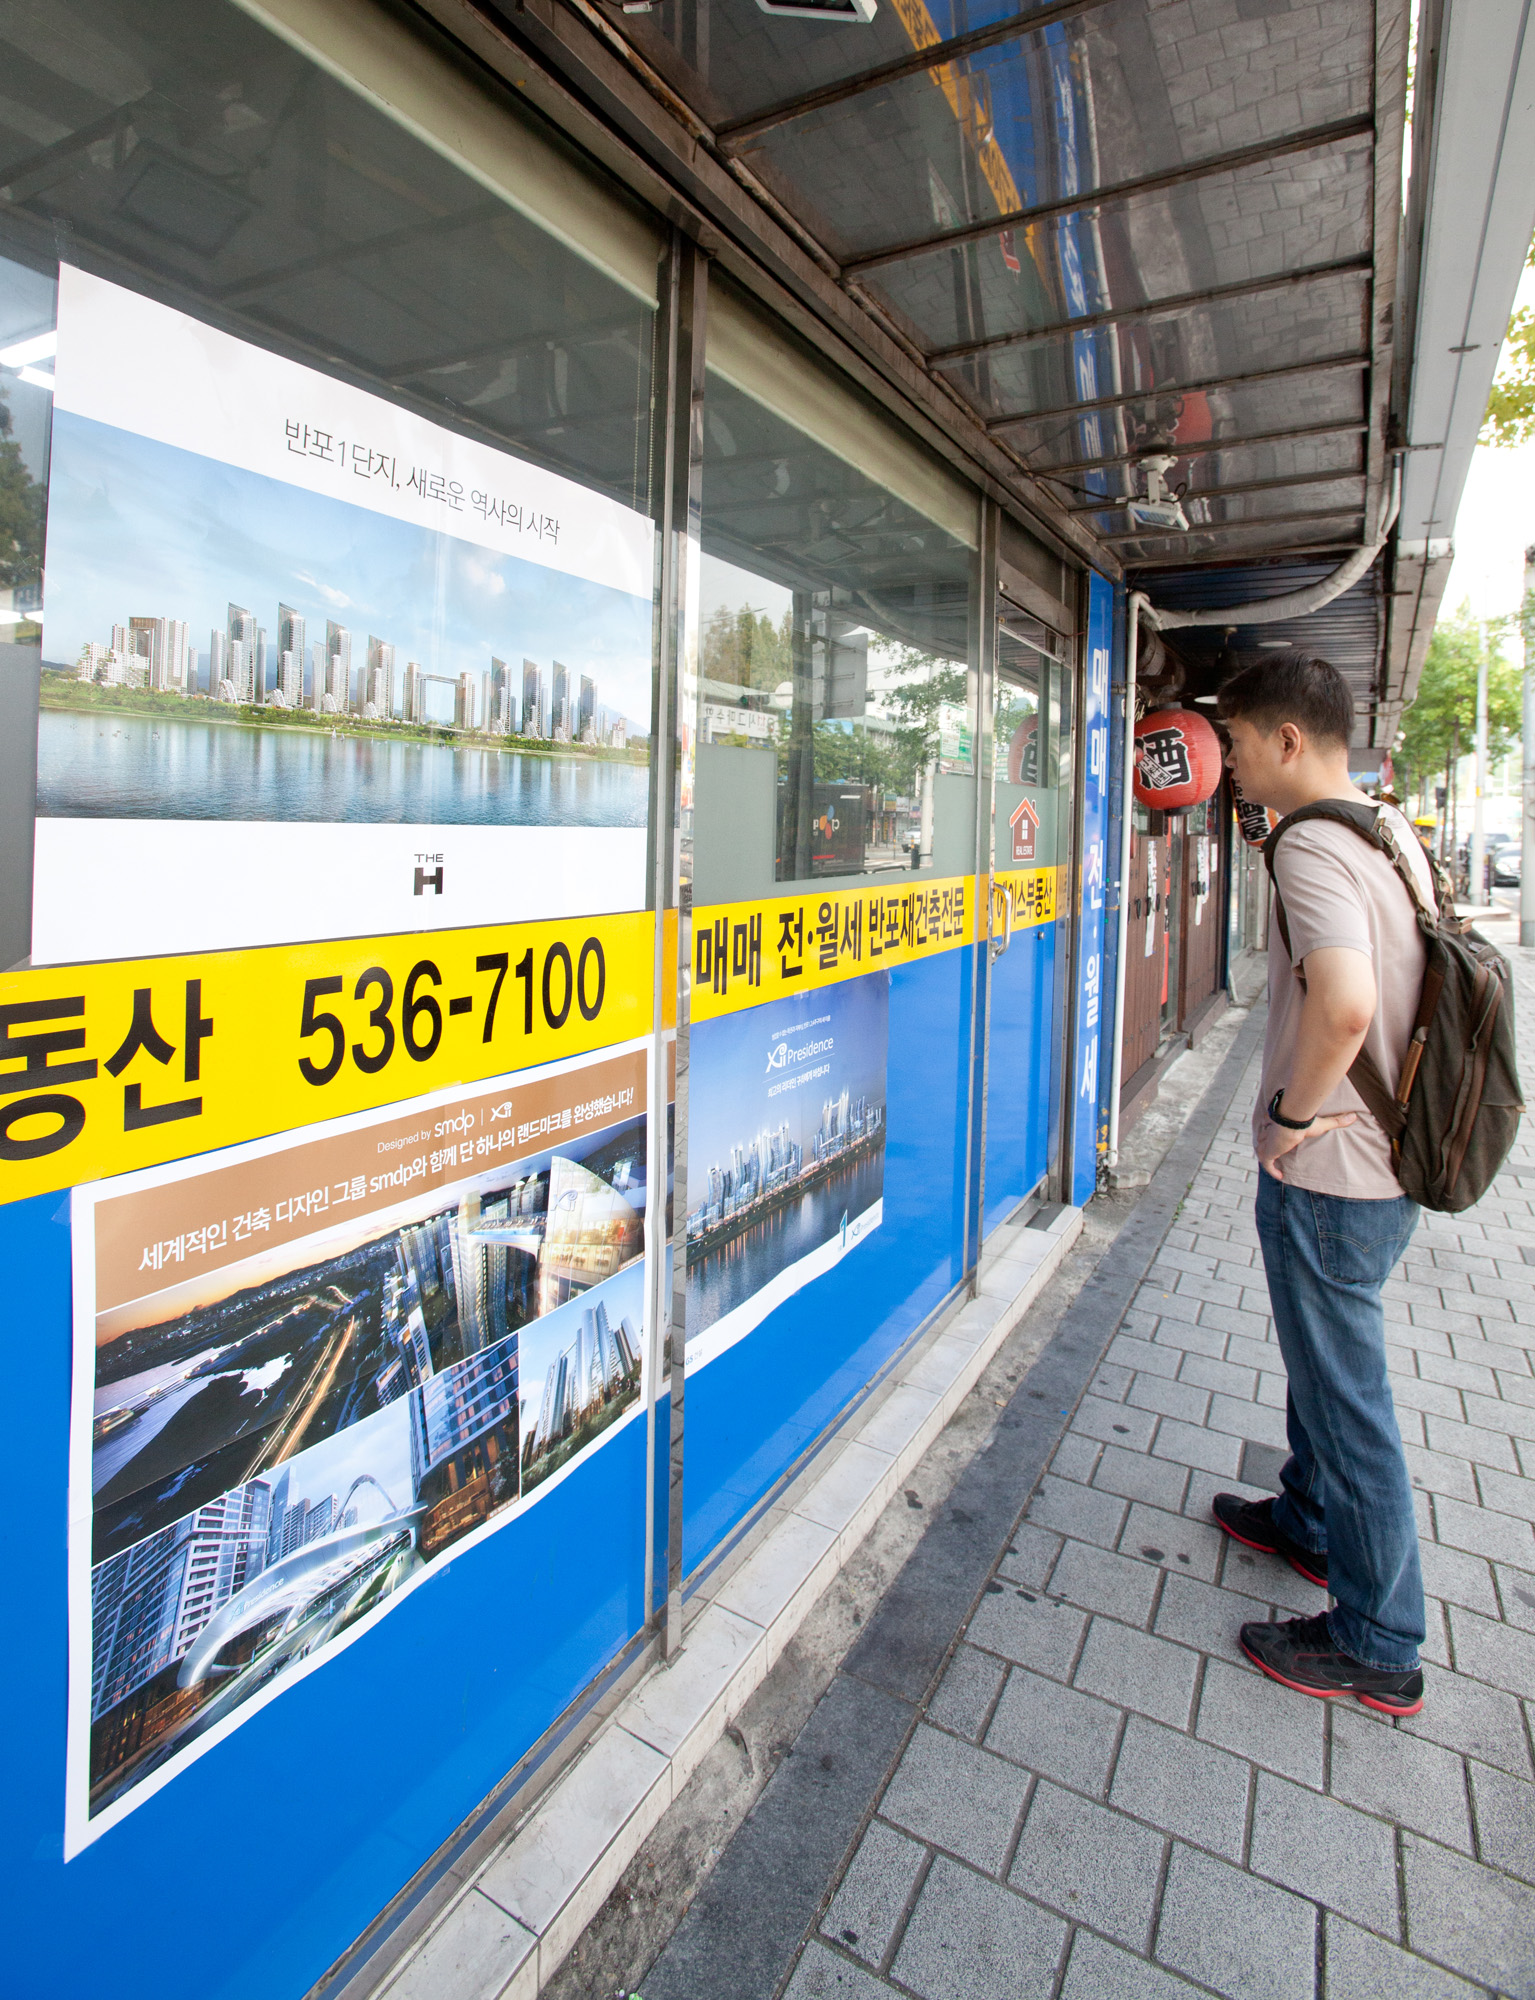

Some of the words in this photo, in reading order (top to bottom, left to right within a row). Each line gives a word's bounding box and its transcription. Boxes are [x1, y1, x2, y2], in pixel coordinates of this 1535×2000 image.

[285, 418, 400, 492] 반포1단지,
[406, 467, 466, 512] 새로운
[470, 489, 523, 532] 역사의
[526, 512, 561, 545] 시작
[1091, 648, 1109, 797] 매매
[413, 853, 444, 863] THE
[413, 866, 444, 896] H
[696, 912, 762, 996] 매매
[777, 899, 863, 980] 전·월세
[869, 886, 965, 957] 반포재건축전문
[298, 936, 607, 1088] 536-7100
[787, 1037, 834, 1064] Presidence
[138, 1220, 228, 1271] 세계적인
[231, 1207, 272, 1242] 건축
[275, 1186, 329, 1223] 디자인
[332, 1174, 368, 1205] 그룹
[369, 1155, 428, 1194] smdp와
[430, 1144, 457, 1174] 함께
[460, 1141, 475, 1164] 단
[476, 1126, 515, 1155] 하나의
[517, 1108, 572, 1143] 랜드마크를
[573, 1087, 635, 1125] 완성했습니다!
[377, 1131, 419, 1154] Designed
[420, 1129, 432, 1142] by
[434, 1108, 475, 1137] smdp
